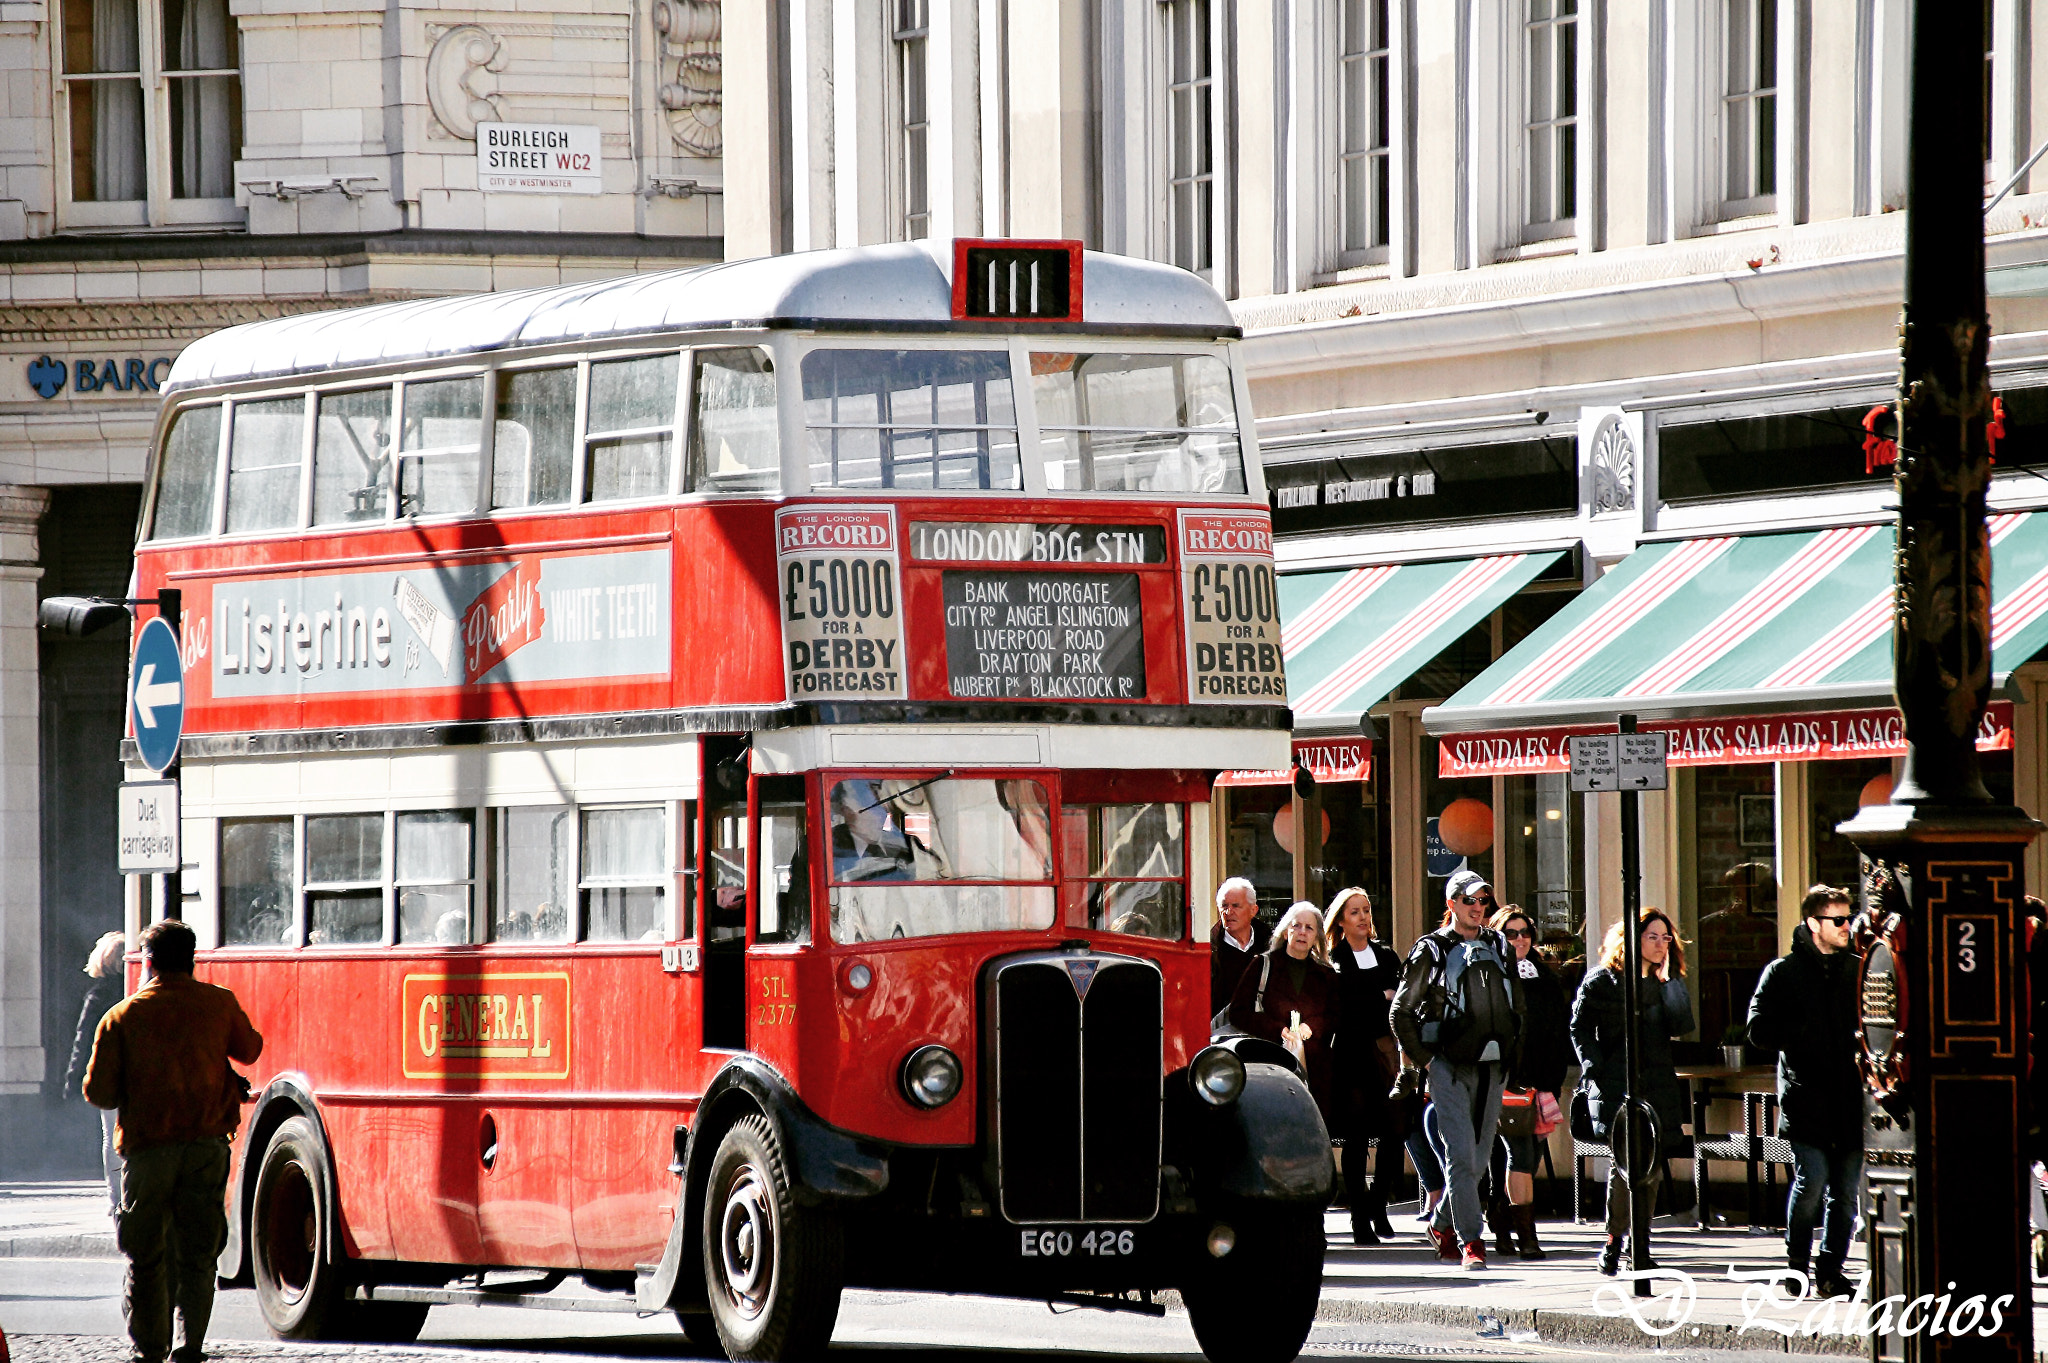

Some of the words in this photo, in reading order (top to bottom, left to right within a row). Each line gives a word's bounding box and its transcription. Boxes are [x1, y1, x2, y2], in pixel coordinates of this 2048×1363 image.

[488, 129, 568, 148] BURLEIGH
[489, 151, 548, 169] STREET
[556, 153, 591, 170] WC2
[489, 178, 505, 186] CITY
[508, 178, 517, 186] OF
[520, 179, 572, 187] WESTMINSTER
[988, 259, 1038, 313] 111
[75, 357, 172, 392] BARC
[1277, 485, 1318, 508] ITALIAN
[1325, 478, 1391, 504] RESTAURANT
[1412, 473, 1436, 495] BAR
[1229, 521, 1268, 529] LONDON
[782, 525, 887, 548] RECORD
[919, 528, 1020, 560] LONDON
[1032, 531, 1082, 562] BDG
[1096, 532, 1144, 564] STN
[786, 559, 893, 621] £5000
[965, 581, 1009, 603] BANK
[1028, 583, 1110, 604] MOORGATE
[220, 591, 392, 675] Listerine
[468, 569, 534, 671] Pearly
[550, 587, 601, 643] WHITE
[606, 583, 657, 638] TEETH
[822, 621, 849, 634] FOR
[854, 621, 863, 634] A
[947, 606, 981, 627] CITY
[1006, 606, 1053, 627] ANGEL
[1057, 606, 1129, 627] ISLINGTON
[974, 629, 1056, 650] LIVERPOOL
[1065, 630, 1105, 650] ROAD
[1226, 625, 1252, 638] FOR
[1257, 626, 1265, 638] A
[789, 639, 896, 671] DERBY
[980, 652, 1051, 673] DRAYTON
[1063, 653, 1103, 674] PARK
[792, 672, 897, 693] FORECAST
[953, 676, 1001, 697] AUBERT
[1031, 676, 1115, 697] BLACKSTOCK
[1588, 740, 1608, 748] loading
[1636, 738, 1656, 746] loading
[1667, 726, 1725, 760] EAKS
[1735, 721, 1820, 756] SALADS
[1298, 745, 1362, 775] WINES
[1591, 767, 1616, 775] Midnight
[1638, 756, 1663, 764] Midnight
[138, 797, 157, 821] Dual
[122, 831, 174, 858] carriageway
[762, 976, 790, 998] STL
[418, 994, 551, 1057] GENERAL
[758, 1004, 797, 1025] 2377
[1021, 1230, 1073, 1256] EGO
[1081, 1230, 1134, 1256] 426
